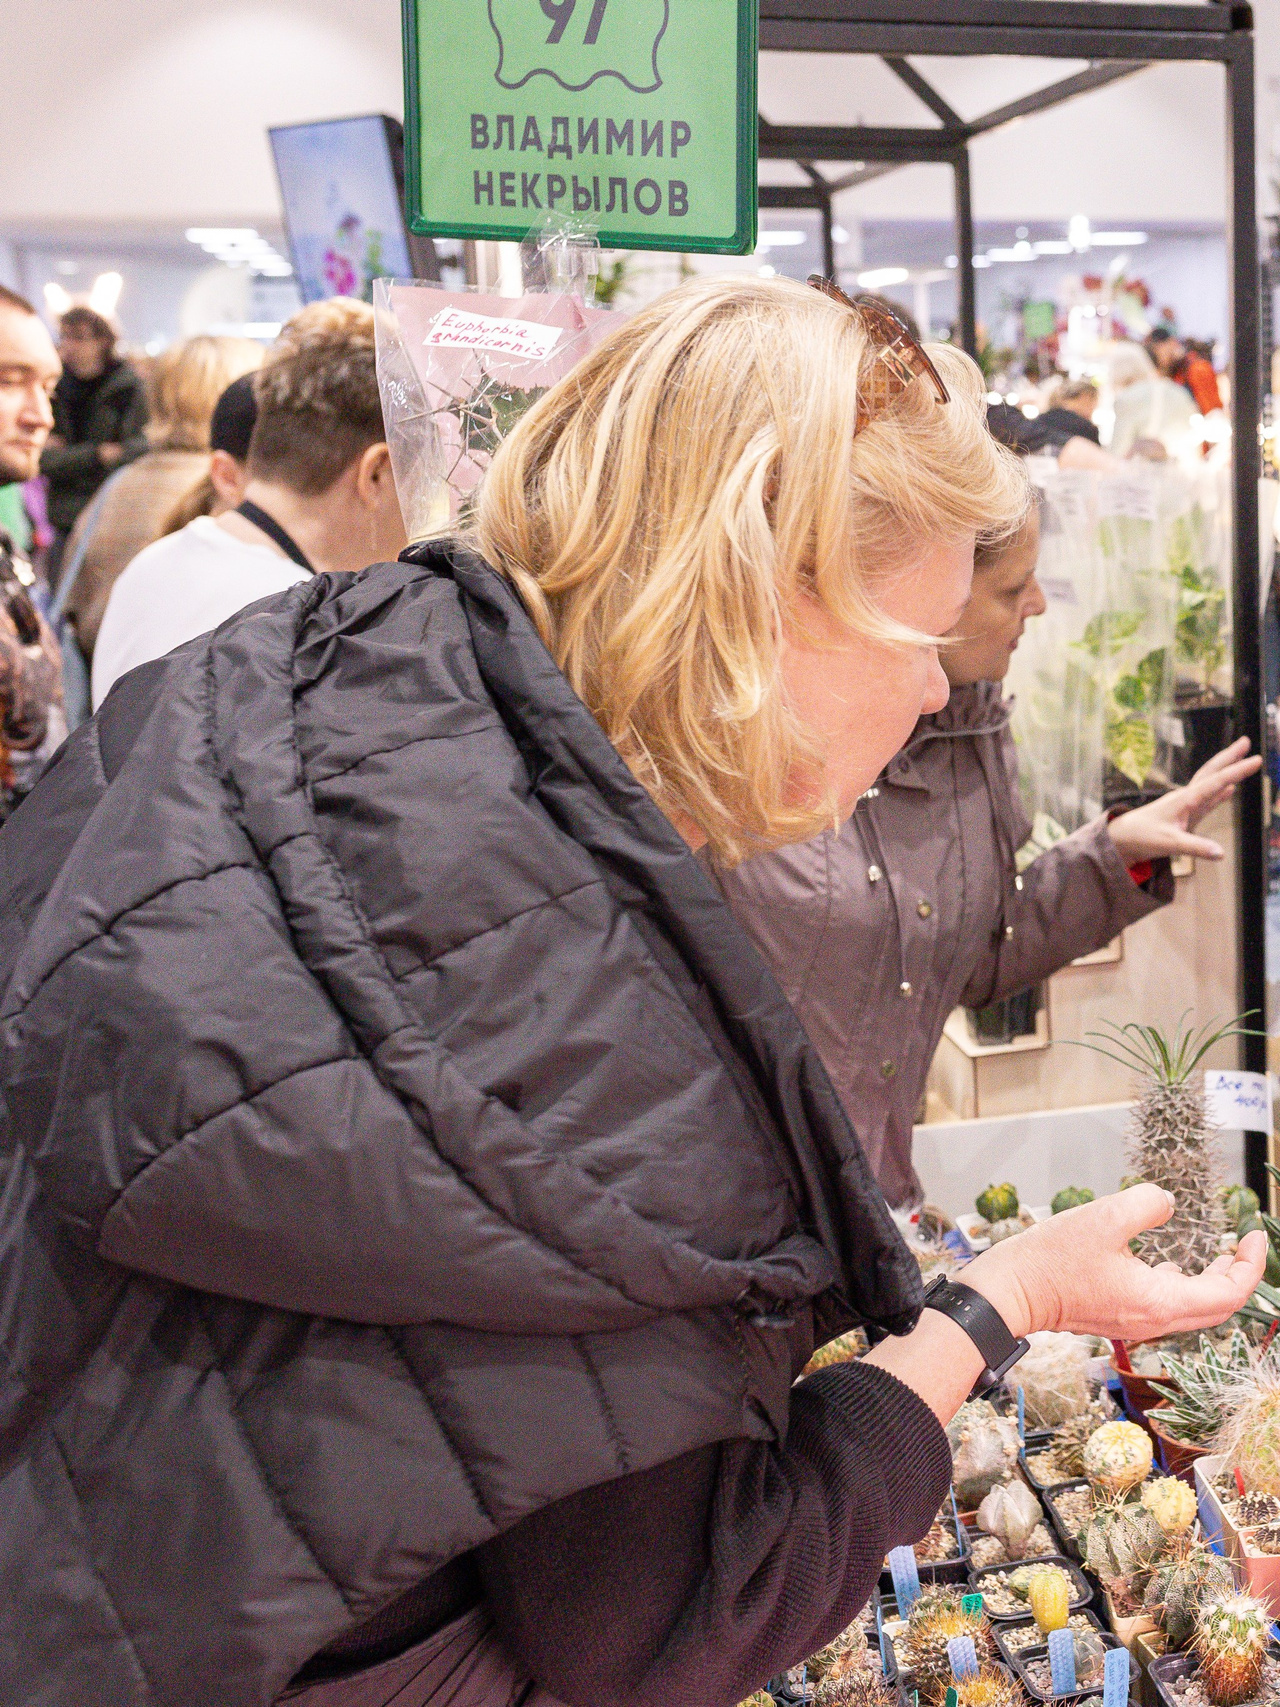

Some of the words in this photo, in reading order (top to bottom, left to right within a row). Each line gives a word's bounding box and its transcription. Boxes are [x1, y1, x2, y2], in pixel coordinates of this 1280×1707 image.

[470, 113, 692, 160] ВЛАДИМИР
[473, 170, 690, 217] НЕКРЫЛОВ
[441, 313, 529, 338] Euphorbia
[430, 332, 546, 357] grandicornis
